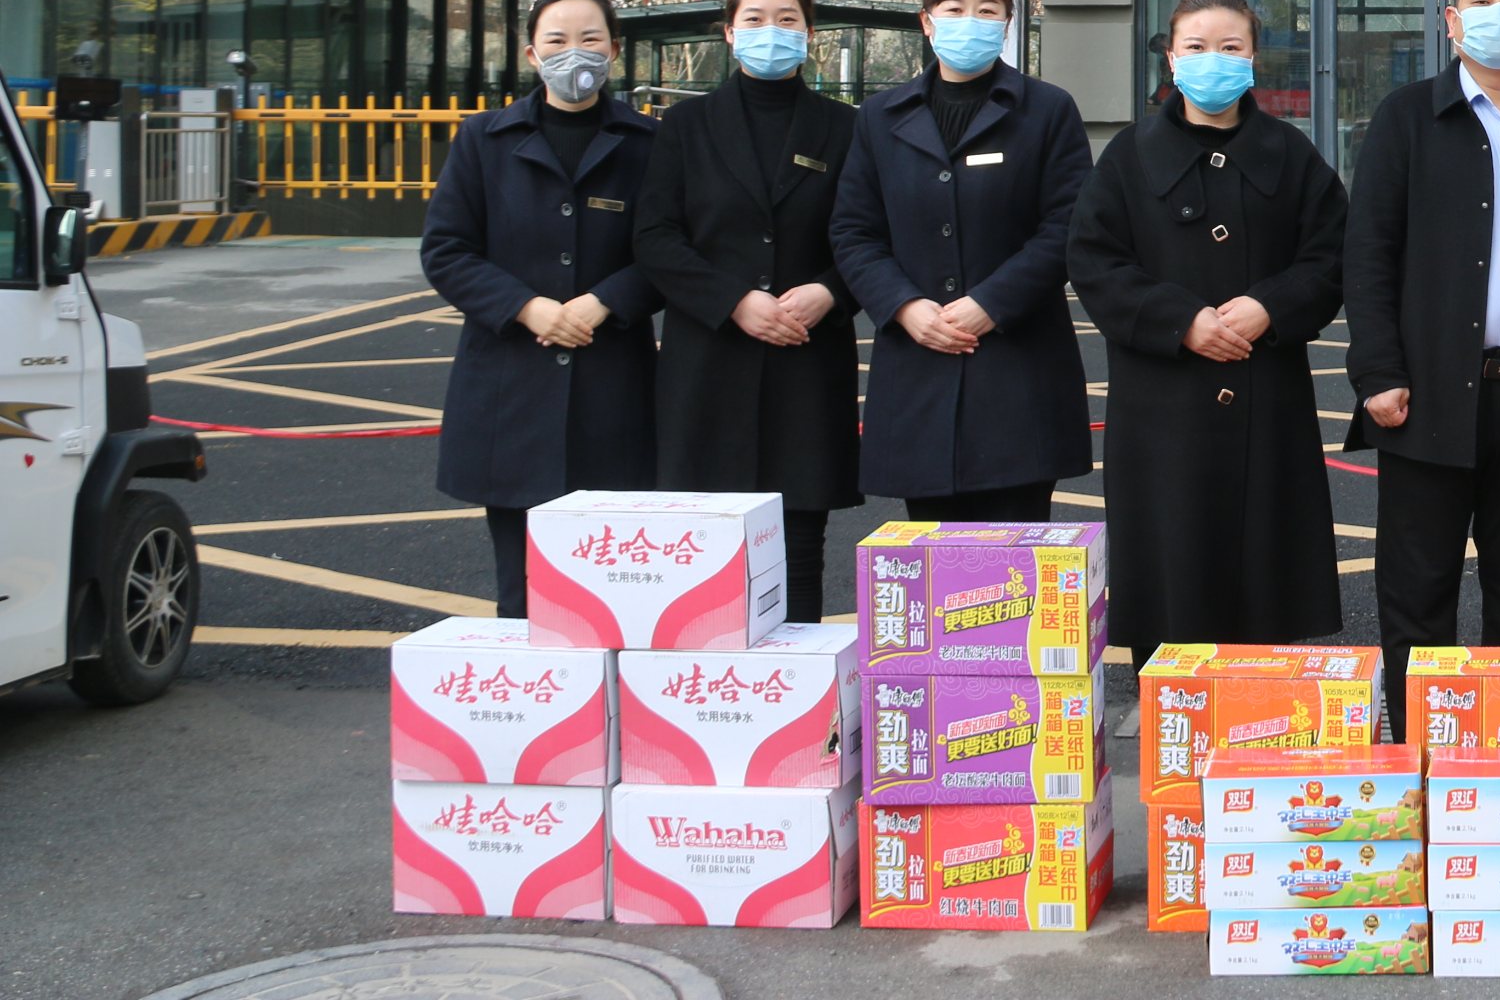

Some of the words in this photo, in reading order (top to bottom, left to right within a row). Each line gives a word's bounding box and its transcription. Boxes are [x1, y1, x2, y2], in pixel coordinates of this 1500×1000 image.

[572, 524, 704, 565] 娃哈哈
[606, 571, 664, 584] 饮用纯净水
[433, 661, 564, 704] 娃哈哈
[661, 663, 793, 704] 娃哈哈
[469, 710, 526, 722] 饮用纯净水
[696, 711, 754, 723] 饮用纯净水
[1227, 791, 1251, 807] 双汇
[1450, 791, 1473, 805] 双汇
[434, 794, 563, 835] 娃哈哈
[647, 816, 788, 850] Wahaha
[468, 841, 524, 853] 饮用纯净水
[686, 854, 725, 864] PURIFIED
[727, 855, 756, 865] WATER
[1227, 856, 1251, 872] 双汇
[1450, 858, 1473, 873] 双汇
[691, 864, 707, 874] FOR
[709, 864, 751, 875] DRINKING
[1231, 923, 1256, 938] 双汇
[1456, 923, 1480, 938] 双汇
